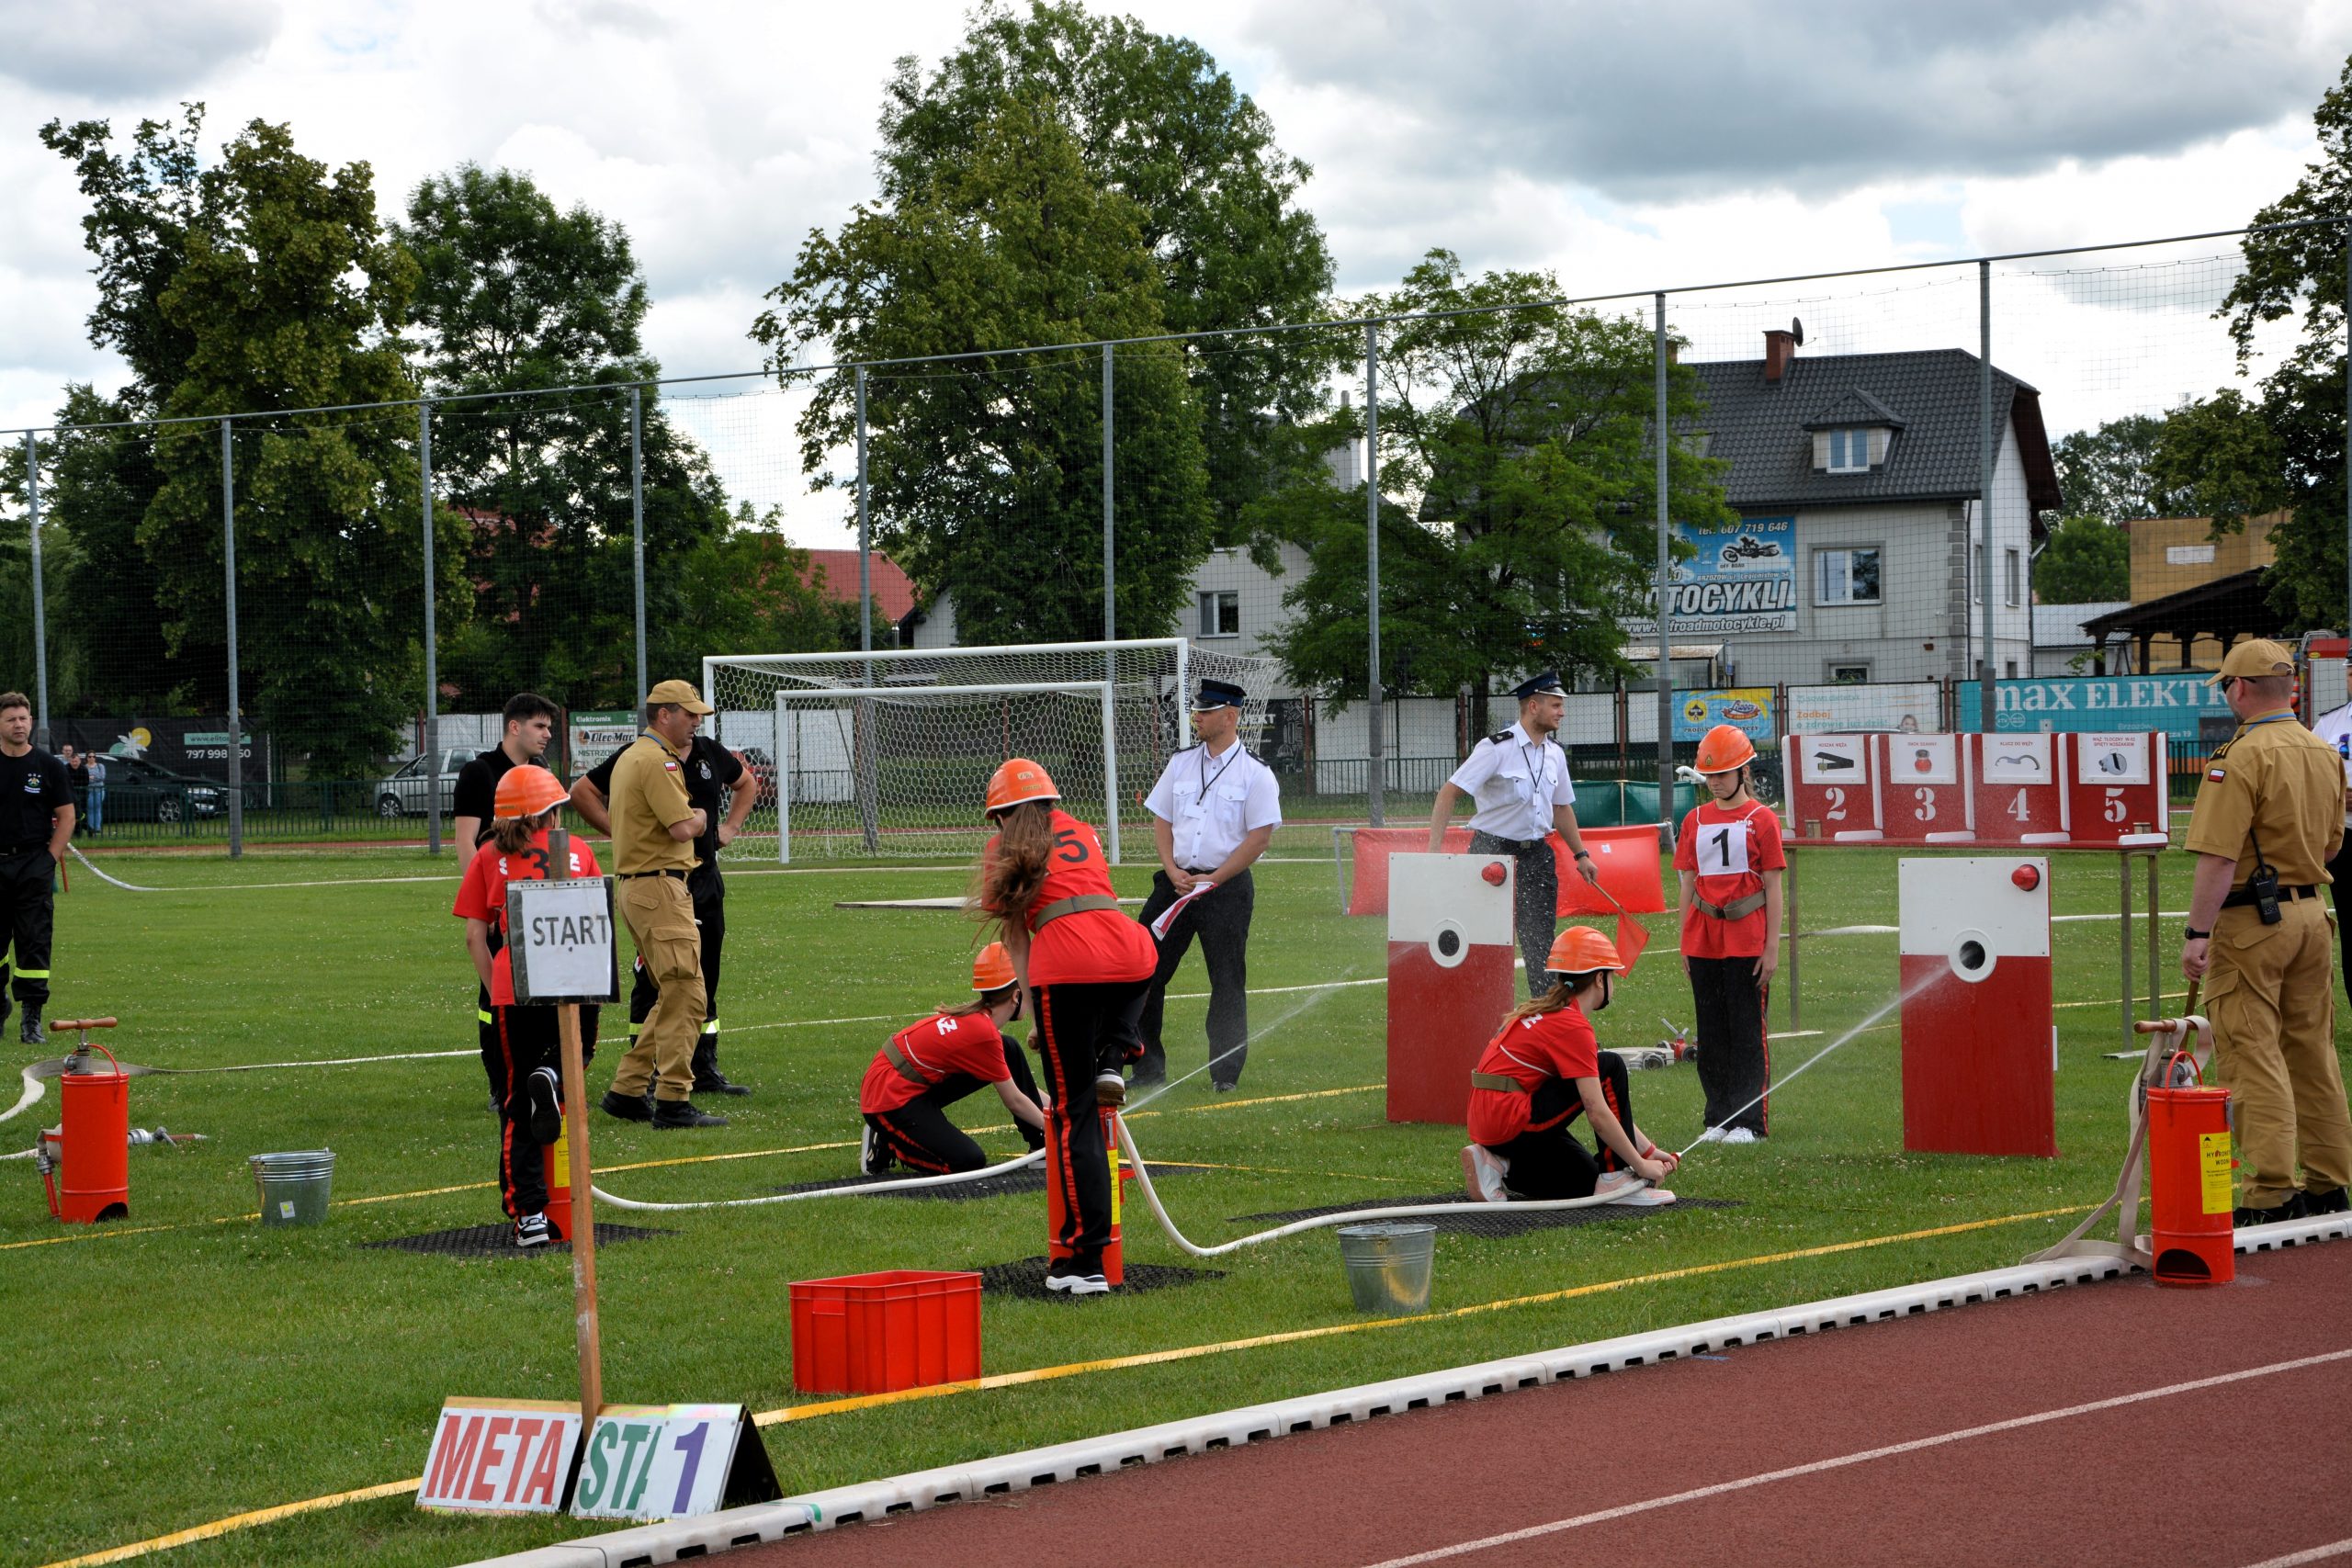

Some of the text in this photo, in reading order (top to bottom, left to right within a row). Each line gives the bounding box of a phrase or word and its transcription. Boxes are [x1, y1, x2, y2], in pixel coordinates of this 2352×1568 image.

[1746, 523, 1765, 533] 719
[1769, 522, 1788, 532] 646
[1619, 580, 1791, 615] OTOCYKLI
[1626, 615, 1786, 634] www.ofroadmotocykle.pl
[1980, 683, 2075, 713] max
[576, 715, 611, 723] Elektromix
[1796, 711, 1832, 719] Zadbaj
[1805, 720, 1844, 728] zdrowie
[591, 732, 635, 742] Oleo-Mac
[186, 750, 206, 760] 797
[207, 749, 228, 759] 998
[1825, 786, 1847, 820] 2
[1915, 786, 1937, 821] 3
[2007, 787, 2030, 821] 4
[2104, 787, 2127, 823] 5
[1052, 829, 1089, 863] 5
[1713, 828, 1730, 867] 1
[521, 848, 550, 879] 3
[532, 914, 608, 946] START
[424, 1415, 566, 1506] META
[672, 1421, 709, 1514] 1
